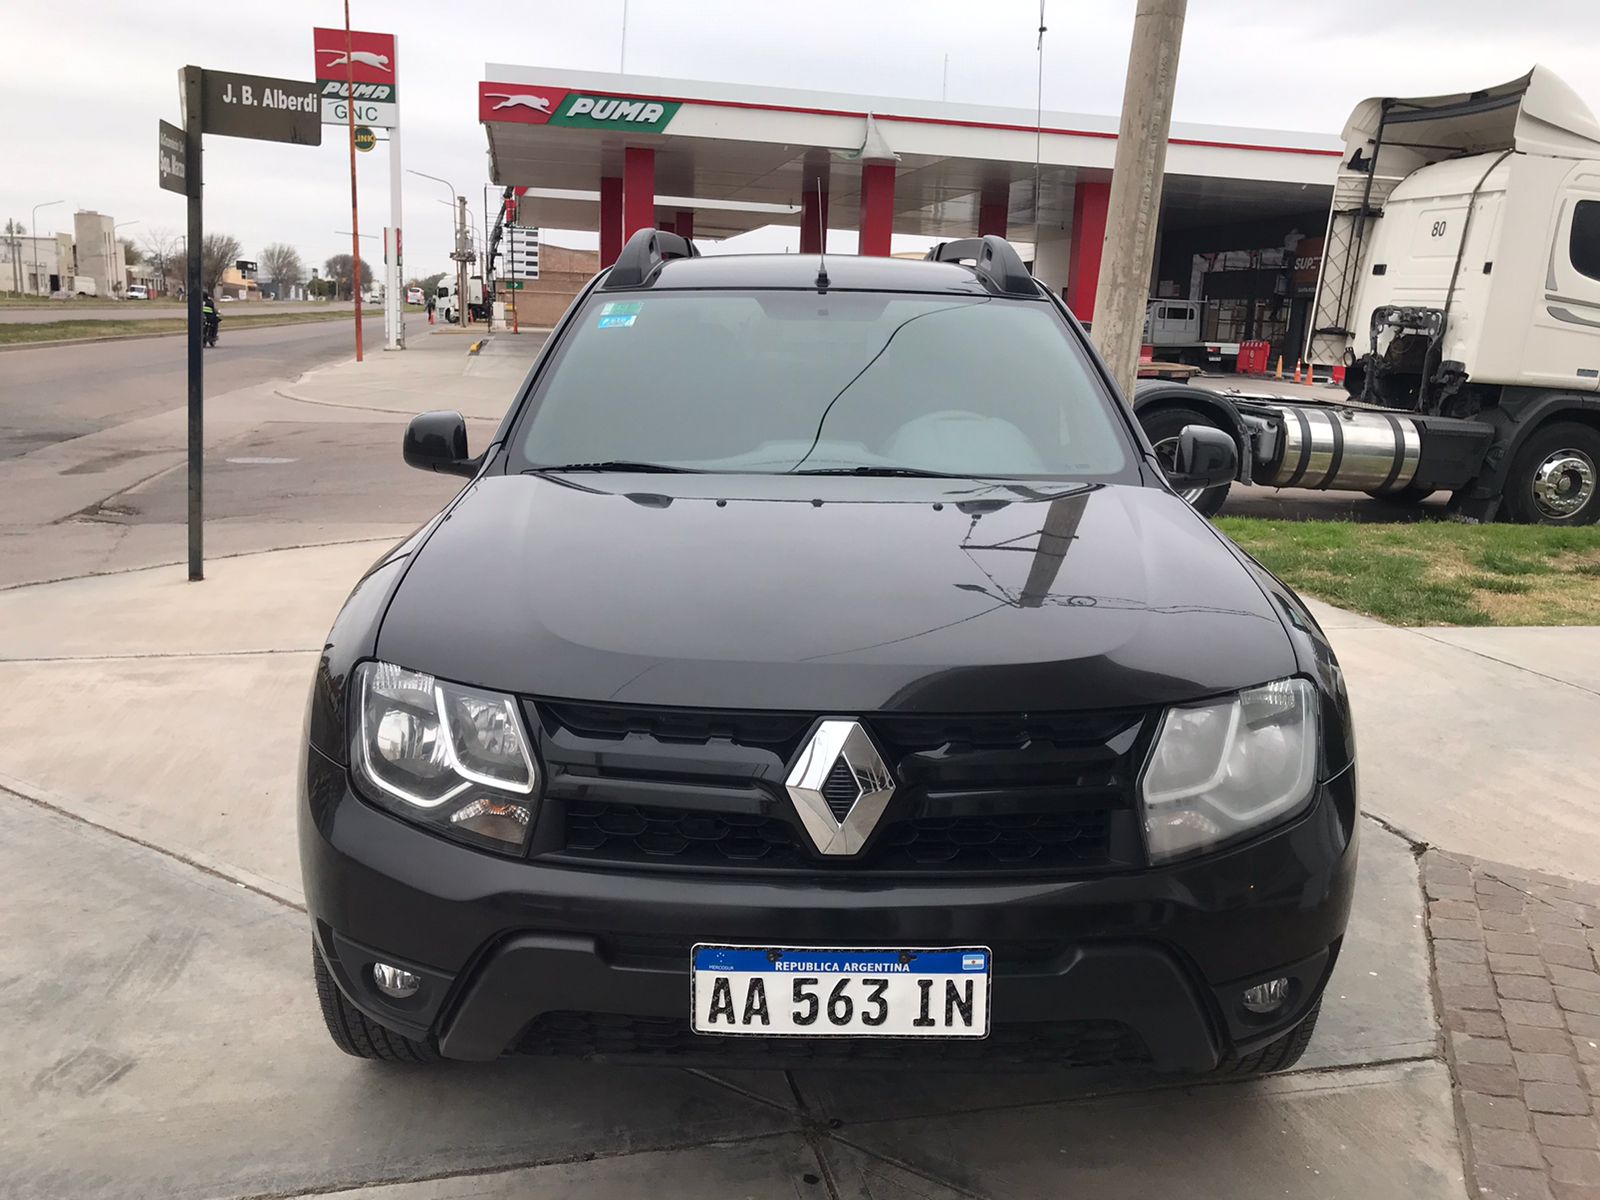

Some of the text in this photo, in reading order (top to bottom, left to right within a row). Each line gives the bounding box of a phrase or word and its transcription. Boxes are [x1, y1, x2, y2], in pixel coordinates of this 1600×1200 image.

[223, 83, 318, 113] J. B. Alberdi
[321, 82, 391, 99] PUMA
[334, 105, 378, 122] GNC
[566, 98, 665, 123] PUMA
[1431, 220, 1447, 237] 80
[775, 961, 910, 973] REPUBLICA ARGENTINA
[708, 977, 974, 1027] AA 563 IN
